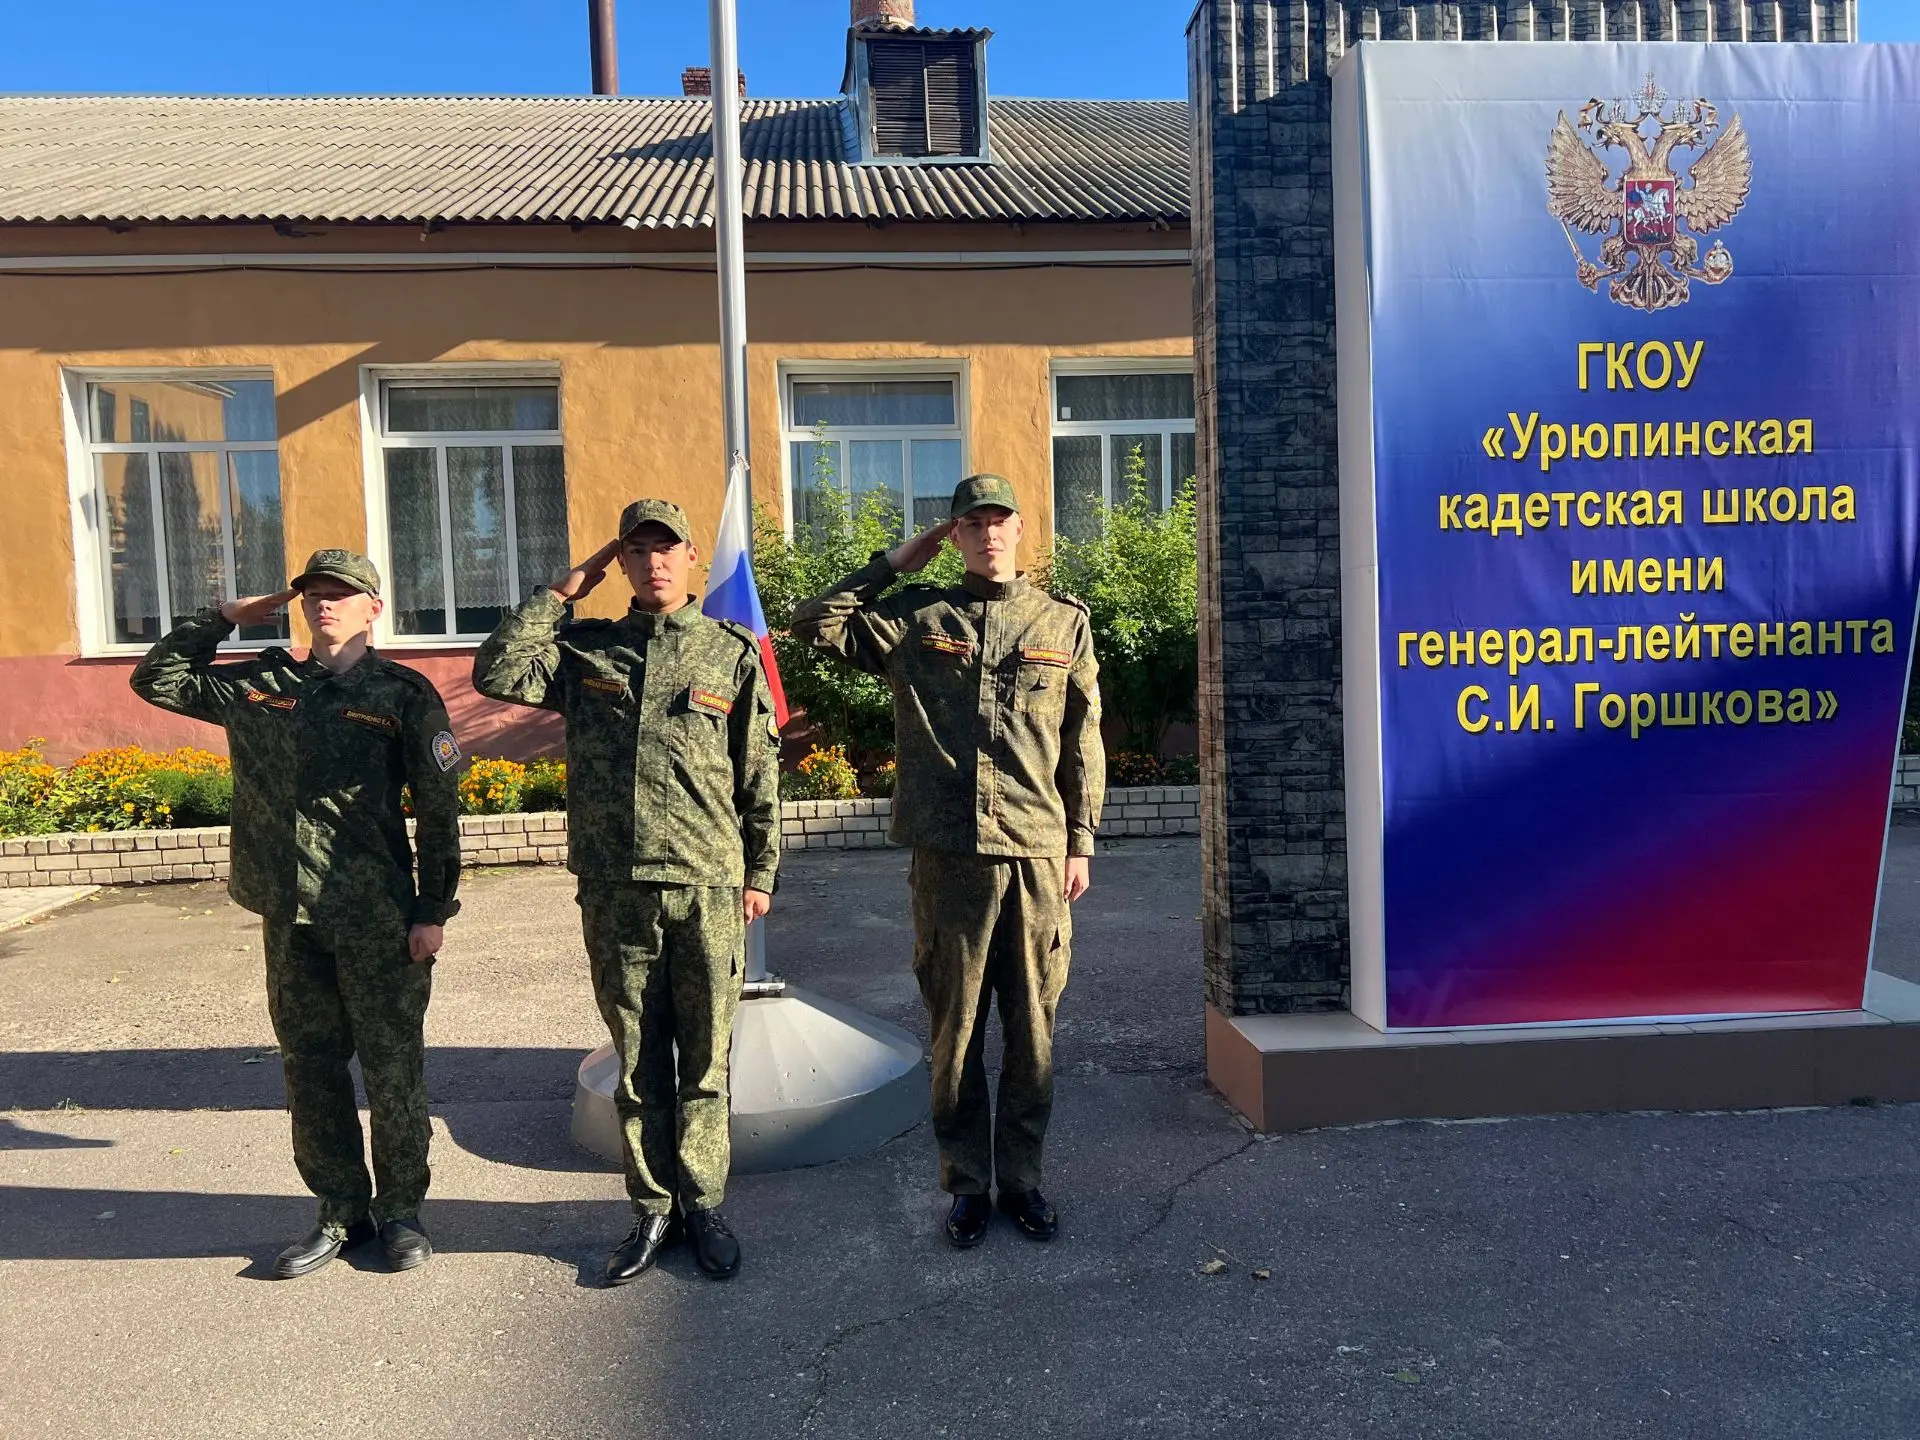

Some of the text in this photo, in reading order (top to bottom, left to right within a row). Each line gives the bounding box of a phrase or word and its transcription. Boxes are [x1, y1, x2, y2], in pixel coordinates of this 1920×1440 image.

[1578, 340, 1705, 390] ГКОУ
[1482, 412, 1813, 472] «Урюпинская
[1439, 485, 1856, 537] кадетская школа
[1571, 556, 1724, 594] имени
[1398, 613, 1894, 677] генерал-лейтенанта
[1457, 682, 1838, 737] С.И. Горшкова»
